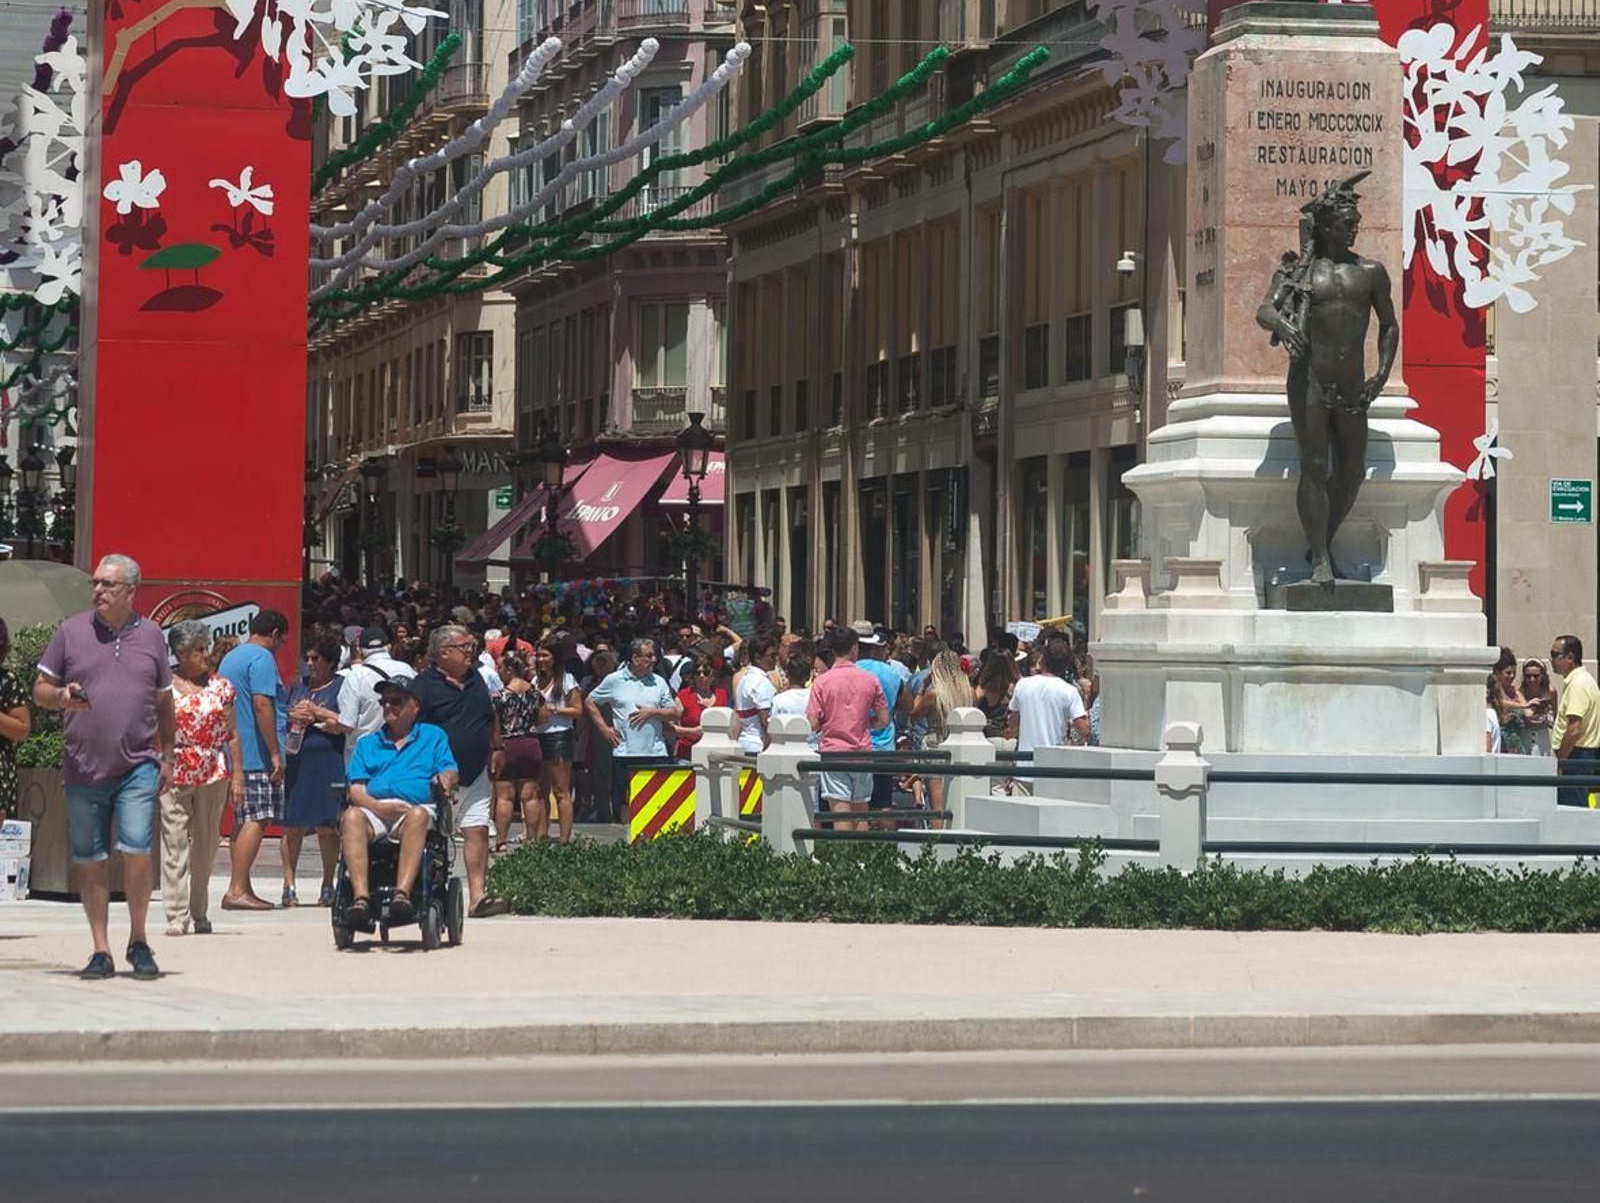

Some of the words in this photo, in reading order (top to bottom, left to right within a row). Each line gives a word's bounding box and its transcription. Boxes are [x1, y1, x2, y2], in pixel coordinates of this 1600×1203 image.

[1261, 80, 1371, 100] INAUGURACION
[1258, 111, 1300, 131] ENERO
[1309, 113, 1383, 132] MDCCCXCIX
[1258, 145, 1373, 166] RESTAURACION
[1276, 178, 1317, 197] MAYO
